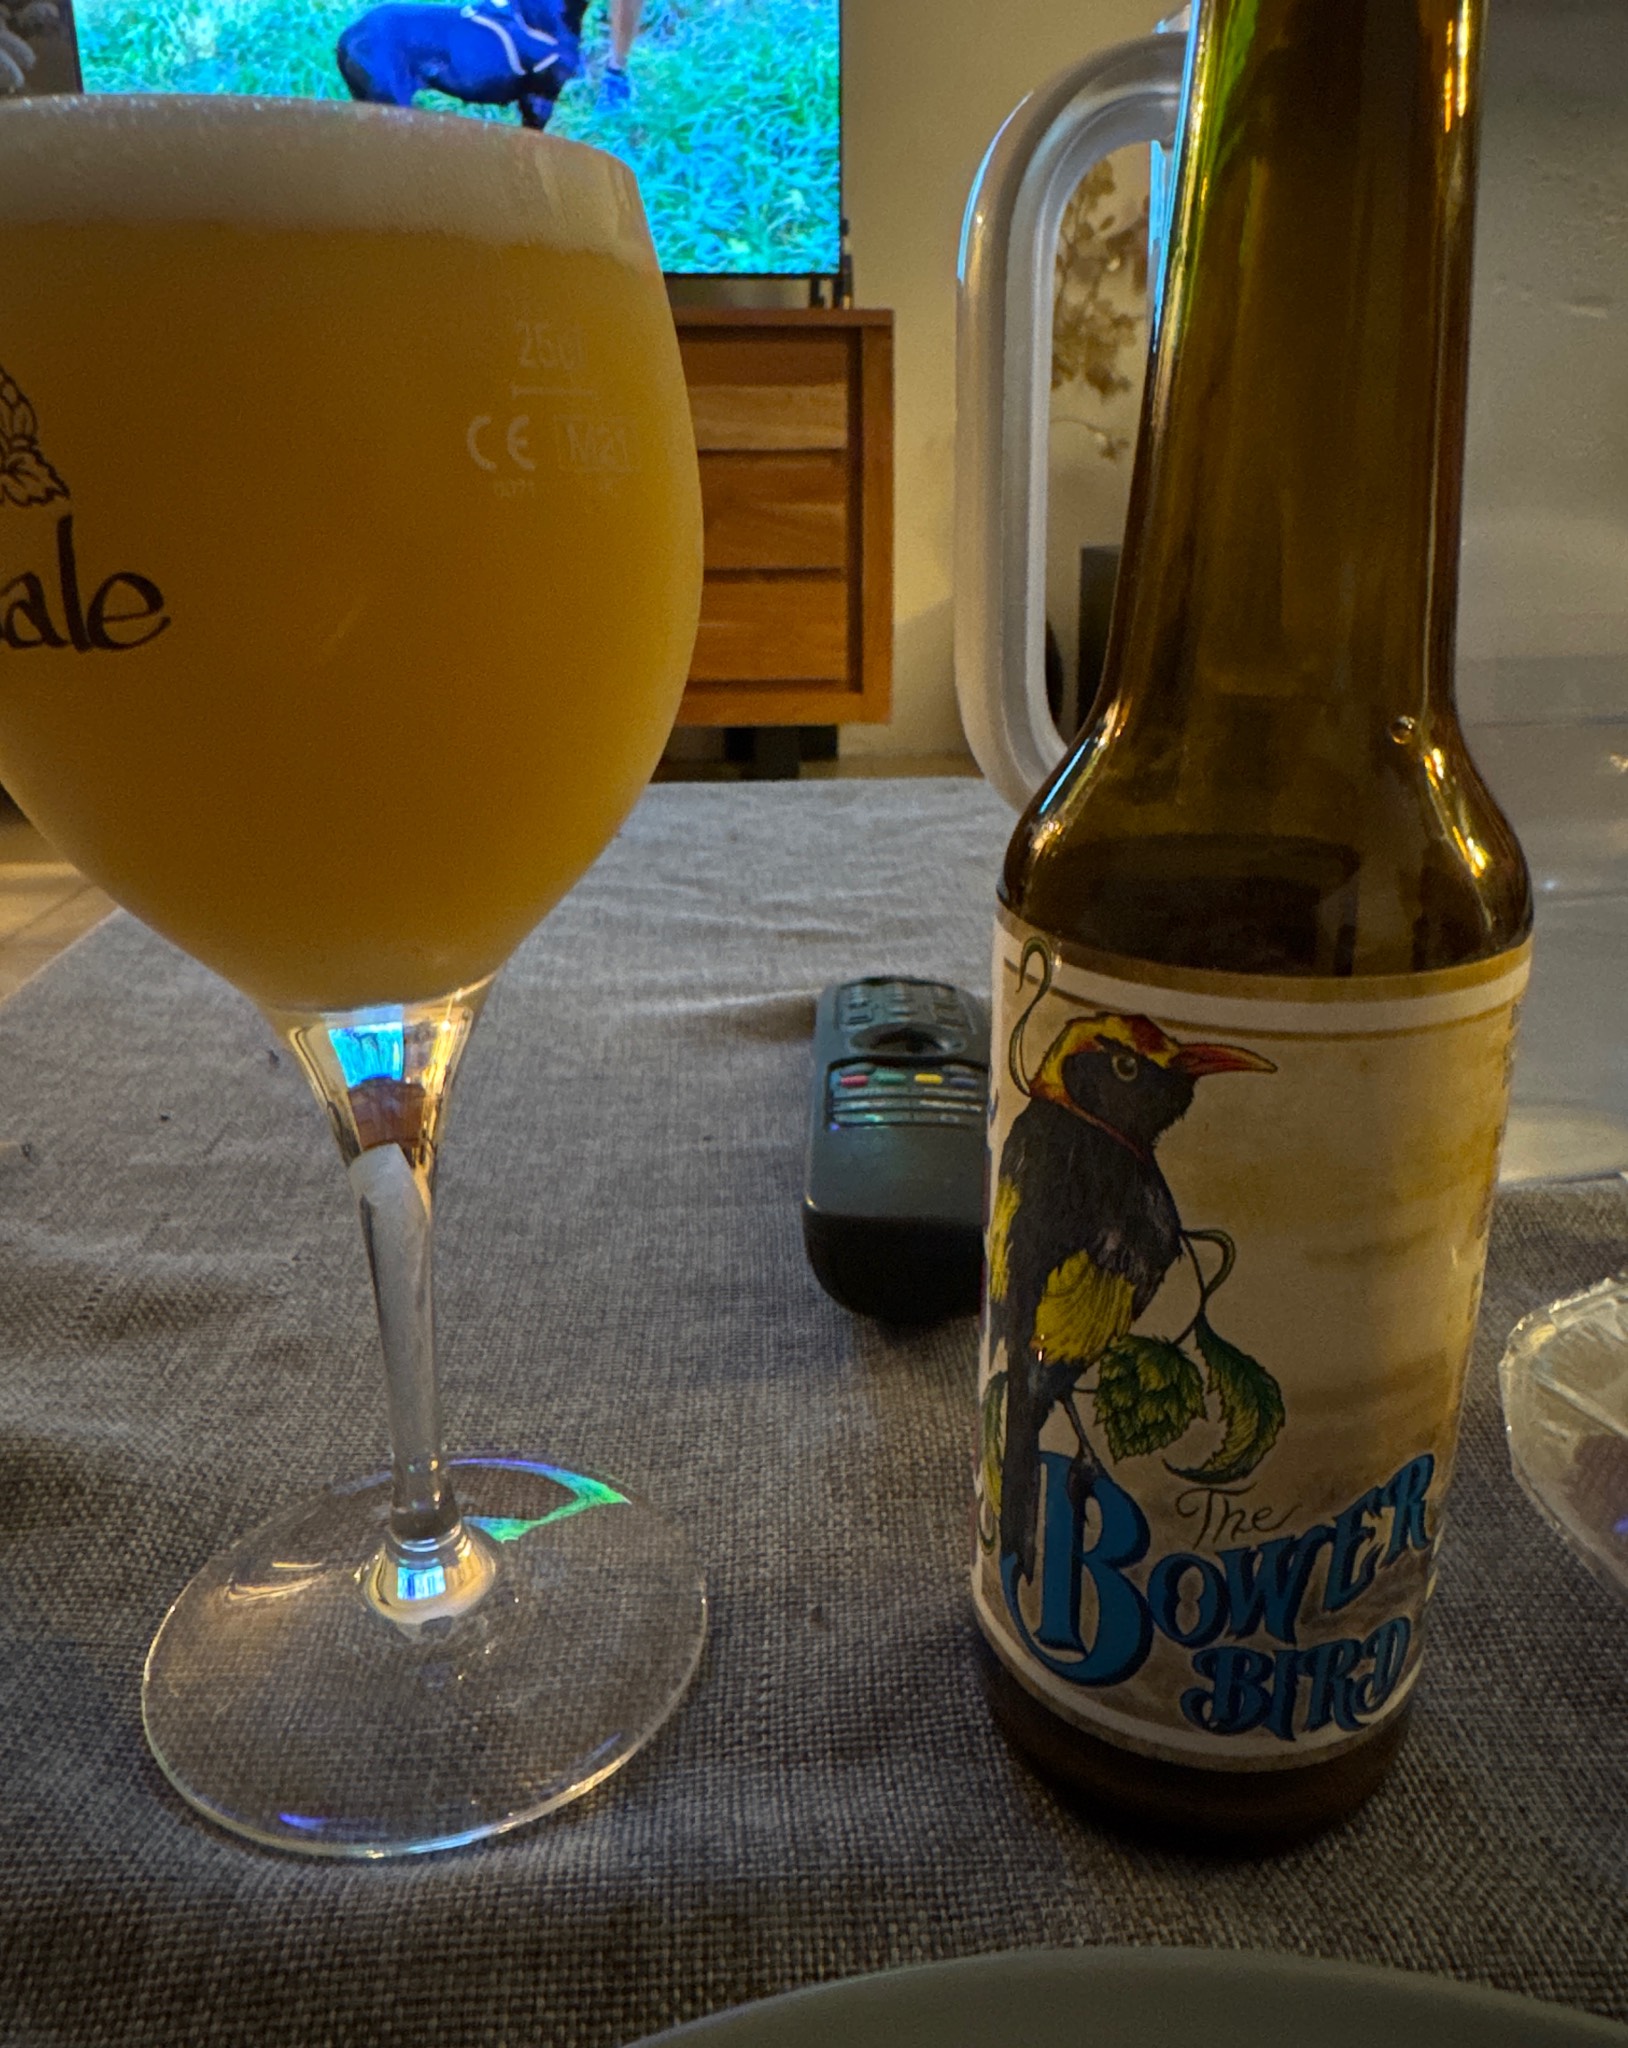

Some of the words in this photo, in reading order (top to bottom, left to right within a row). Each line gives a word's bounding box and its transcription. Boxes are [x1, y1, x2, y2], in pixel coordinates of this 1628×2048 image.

[0, 514, 172, 654] ale
[1174, 1481, 1303, 1549] The
[1179, 1616, 1412, 1743] BIRD
